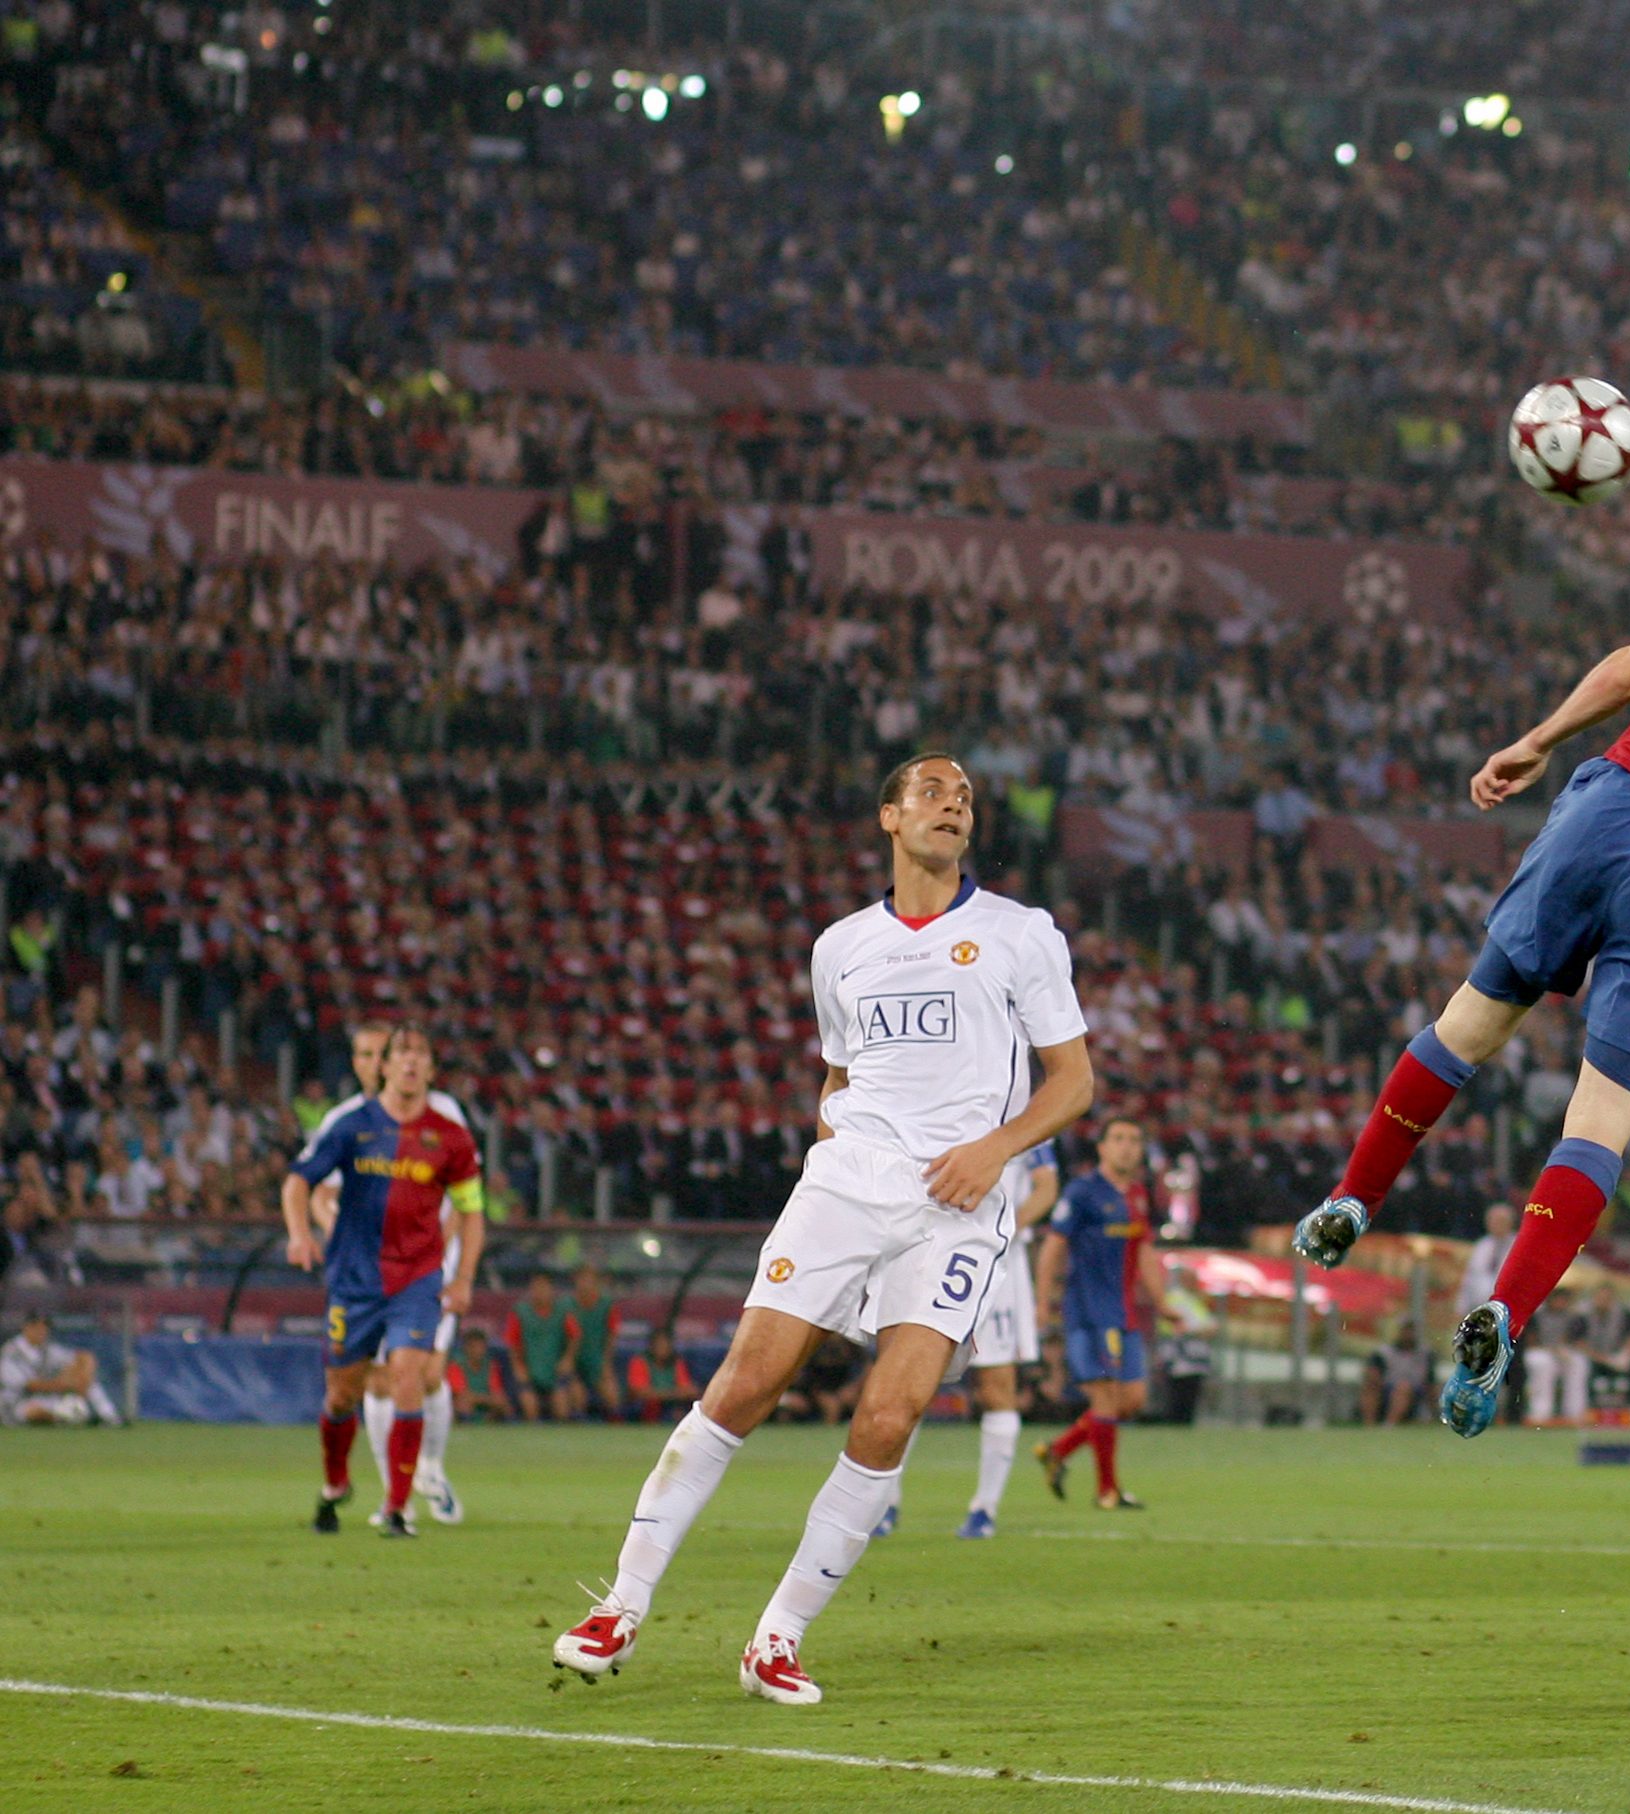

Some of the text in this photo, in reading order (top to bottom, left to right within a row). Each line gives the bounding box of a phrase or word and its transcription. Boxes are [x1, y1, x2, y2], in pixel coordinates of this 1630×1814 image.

[846, 534, 1181, 602] ROMA 2009
[866, 1000, 950, 1041] AIG
[354, 1153, 412, 1178] unicef
[941, 1252, 979, 1301] 5
[328, 1306, 347, 1342] 5
